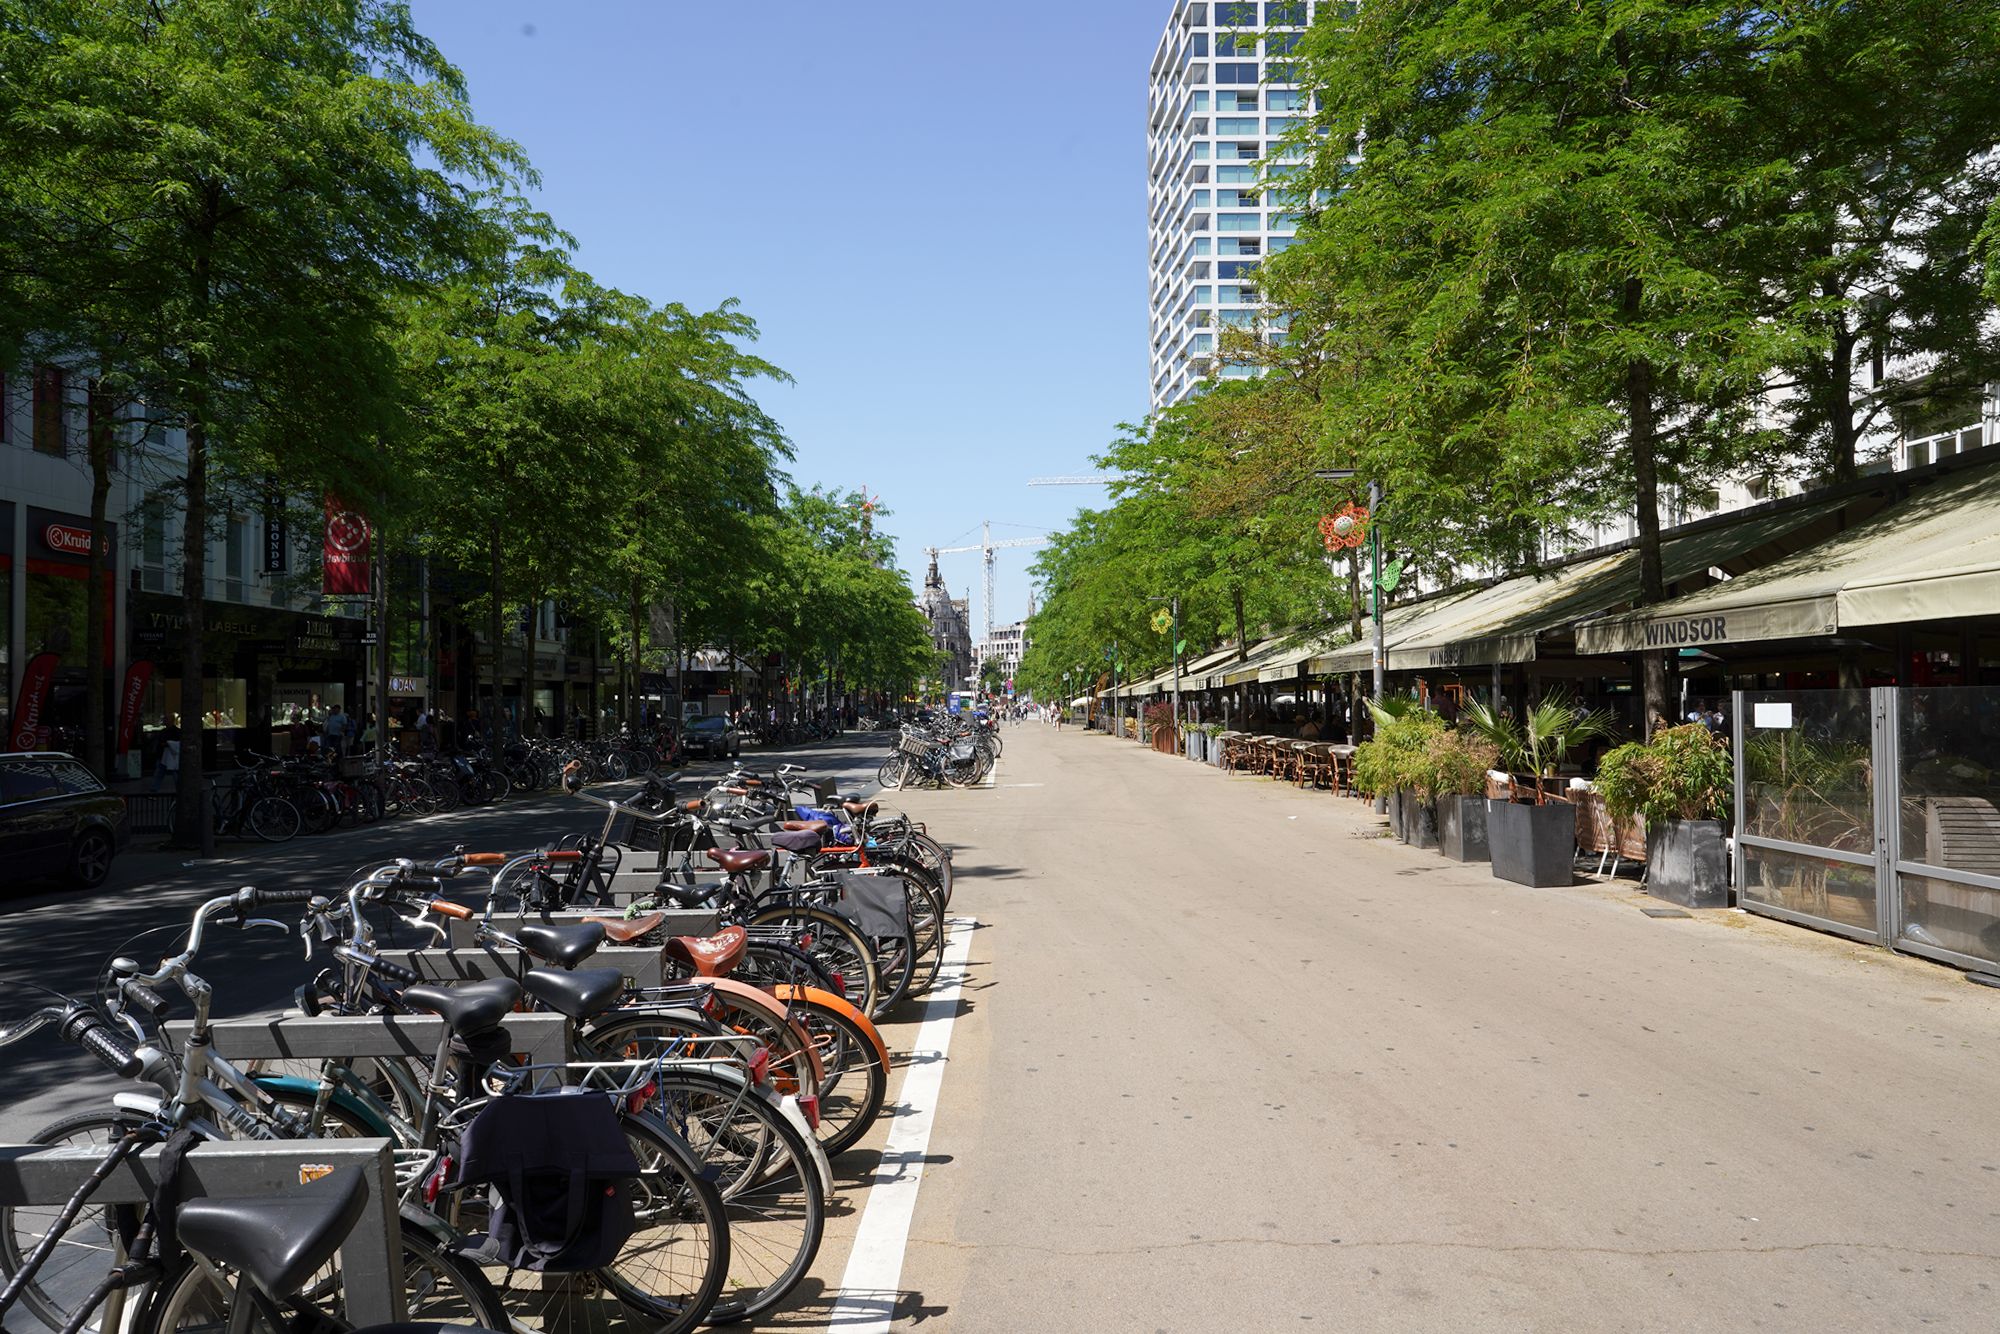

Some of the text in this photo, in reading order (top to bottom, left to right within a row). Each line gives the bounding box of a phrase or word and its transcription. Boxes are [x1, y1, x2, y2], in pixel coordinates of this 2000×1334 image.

[64, 531, 106, 553] Kruid
[208, 620, 257, 636] LABELLE
[1647, 616, 1727, 646] WINDSOR
[1430, 648, 1465, 666] WINDSOR
